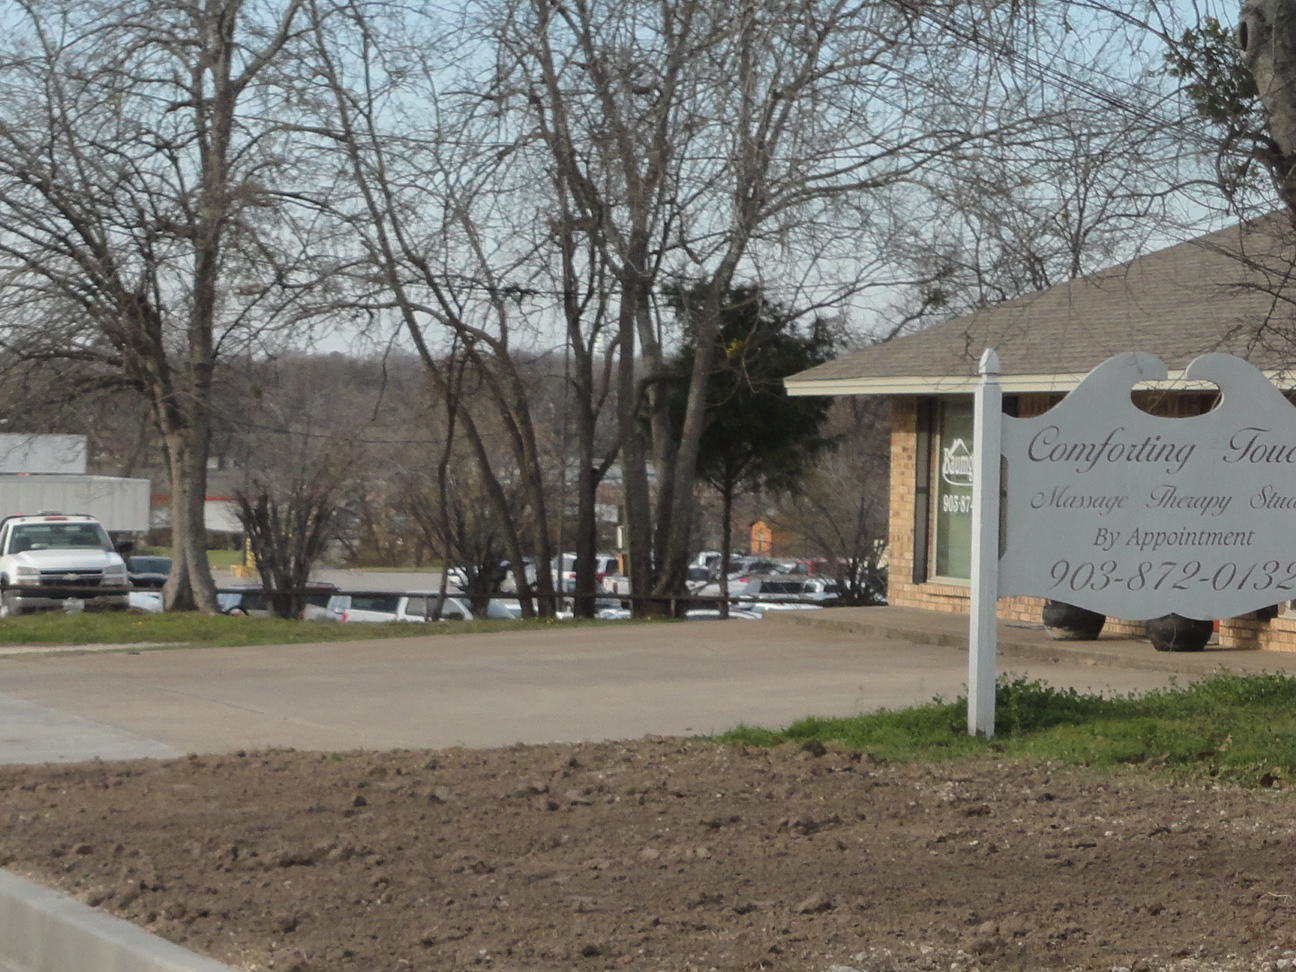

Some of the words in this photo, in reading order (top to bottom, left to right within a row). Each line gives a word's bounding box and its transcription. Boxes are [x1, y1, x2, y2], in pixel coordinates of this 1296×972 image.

[1027, 424, 1197, 475] Comforting
[1030, 484, 1130, 517] Massage
[1145, 484, 1233, 517] Therapy
[1092, 527, 1121, 551] By
[1125, 526, 1257, 552] Appointment
[1047, 558, 1296, 592] 903-872-0132
